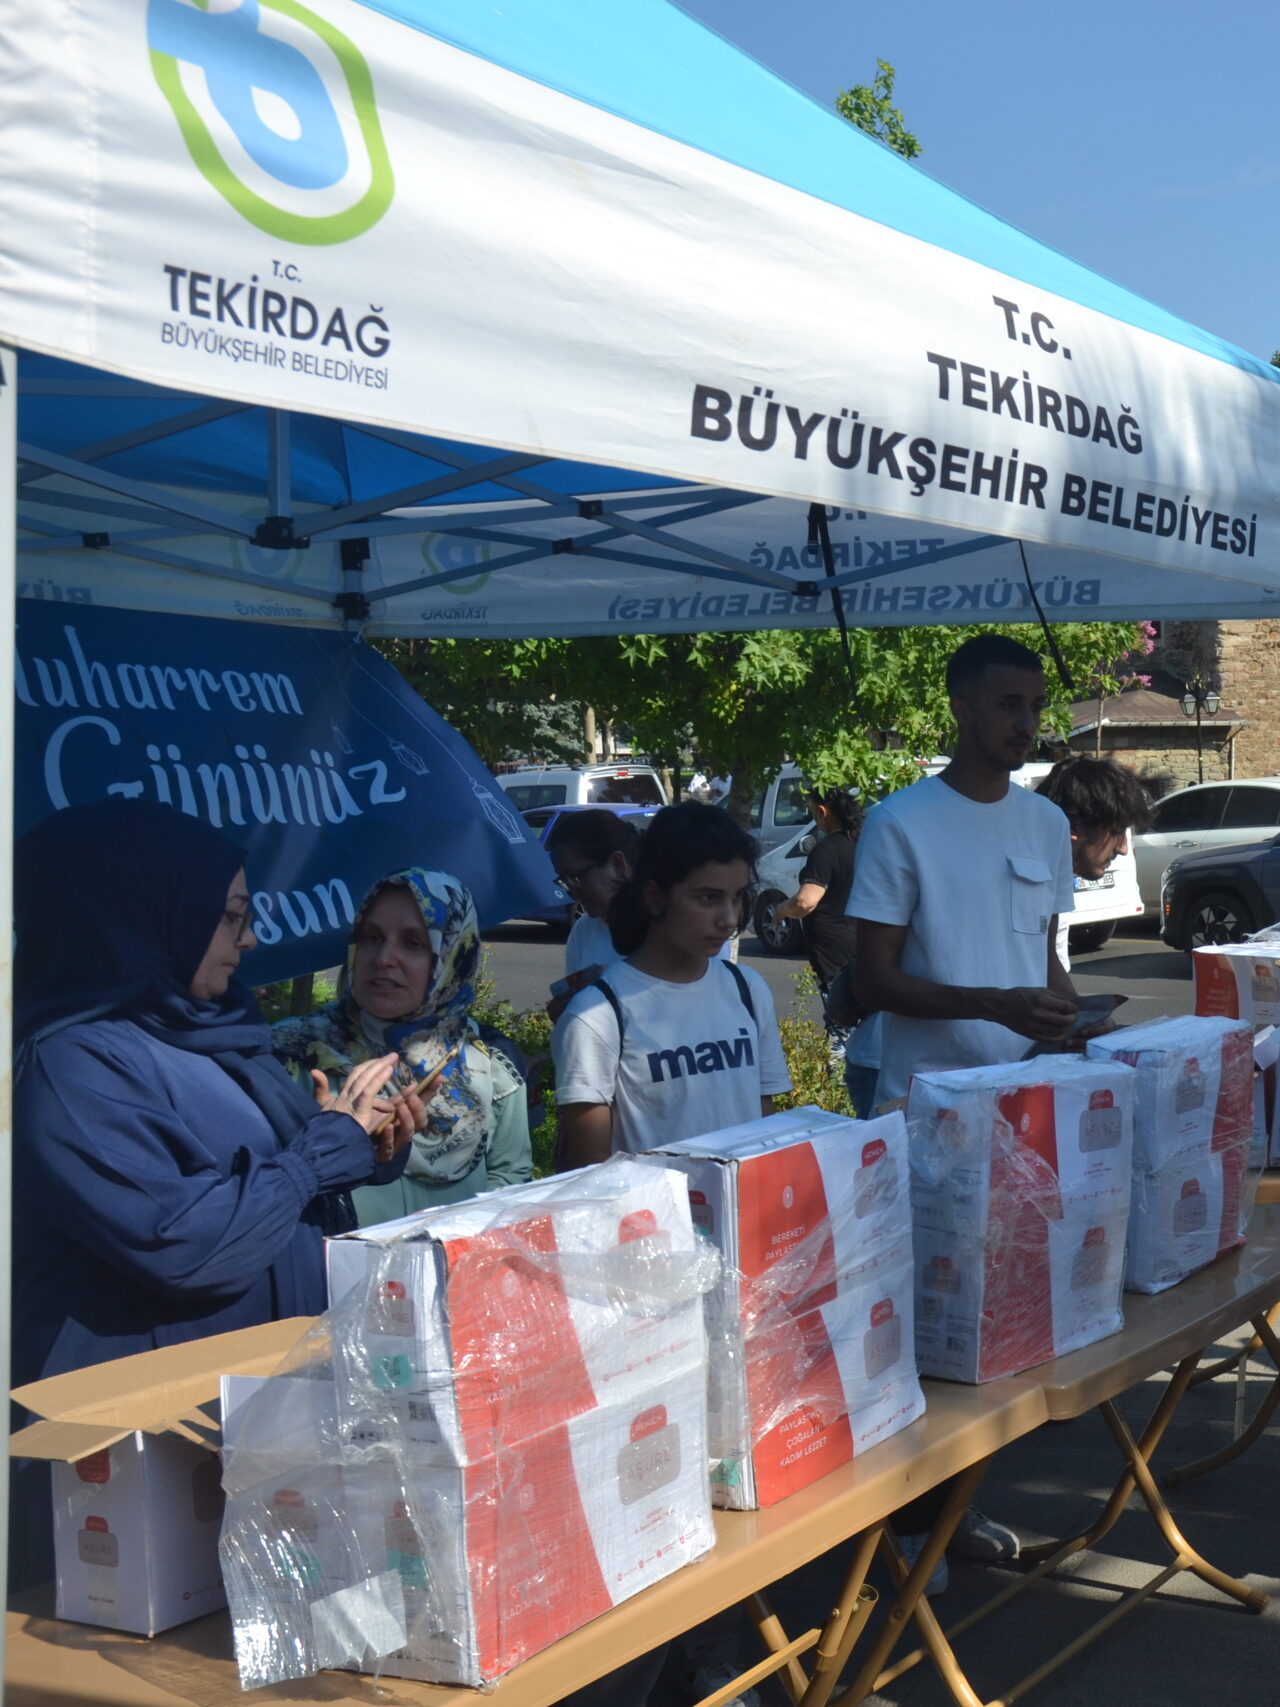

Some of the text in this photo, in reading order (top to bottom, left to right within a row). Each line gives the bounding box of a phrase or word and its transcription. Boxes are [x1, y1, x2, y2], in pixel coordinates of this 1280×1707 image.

[163, 263, 391, 359] TEKİRDAĞ
[271, 259, 302, 283] T.C.
[161, 321, 389, 391] BÜYÜKŞEHİR BELEDİYESİ
[992, 294, 1072, 361] T.C.
[926, 350, 1144, 456] TEKİRDAĞ
[690, 383, 1258, 558] BÜYÜKŞEHİR BELEDİYESİ
[14, 625, 304, 716] uharrem
[44, 715, 407, 829] Gününüz
[646, 1027, 755, 1084] mavi
